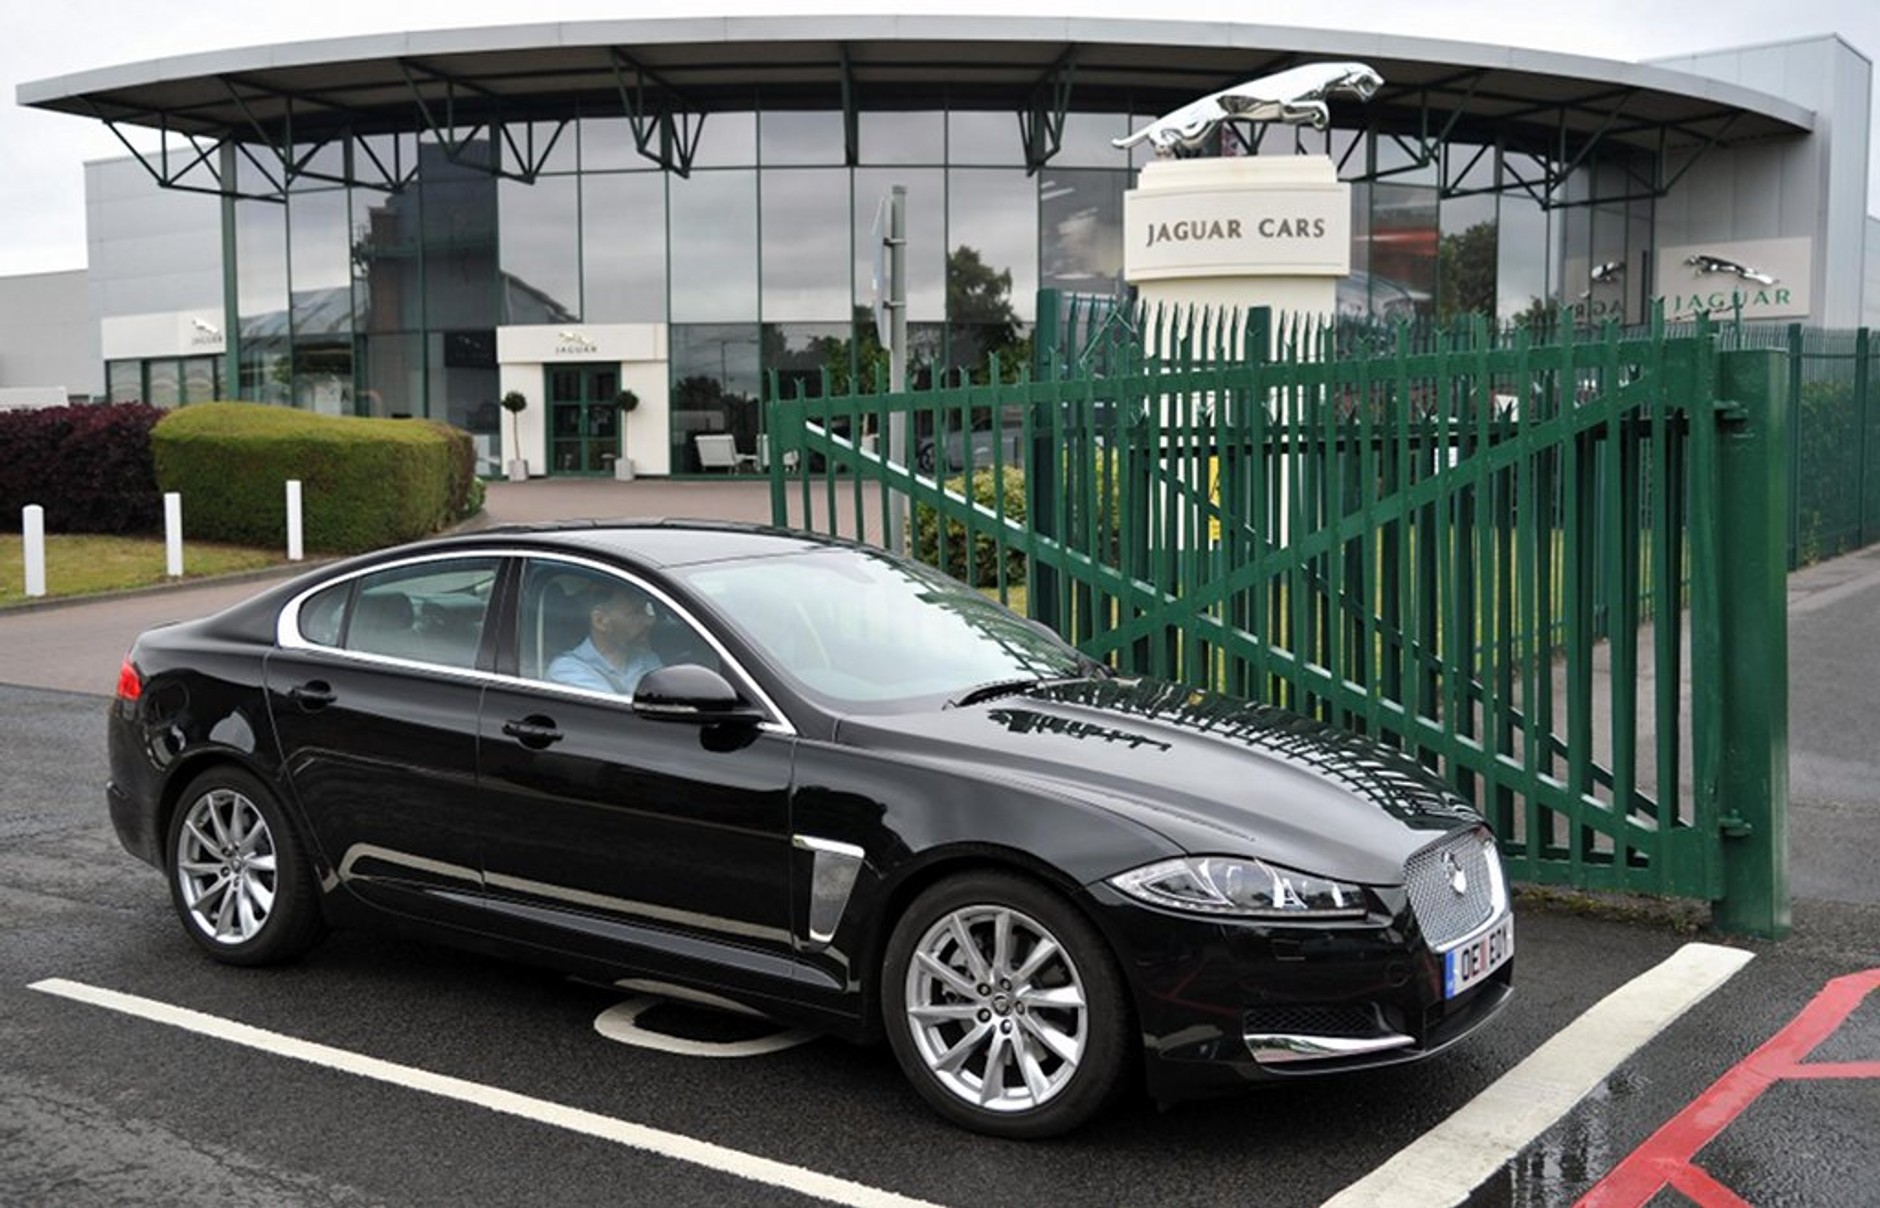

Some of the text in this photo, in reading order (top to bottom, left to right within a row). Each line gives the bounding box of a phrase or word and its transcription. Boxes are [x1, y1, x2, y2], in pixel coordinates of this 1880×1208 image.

[1146, 218, 1325, 247] JAGUAR CARS
[1674, 288, 1791, 312] JAGUAR
